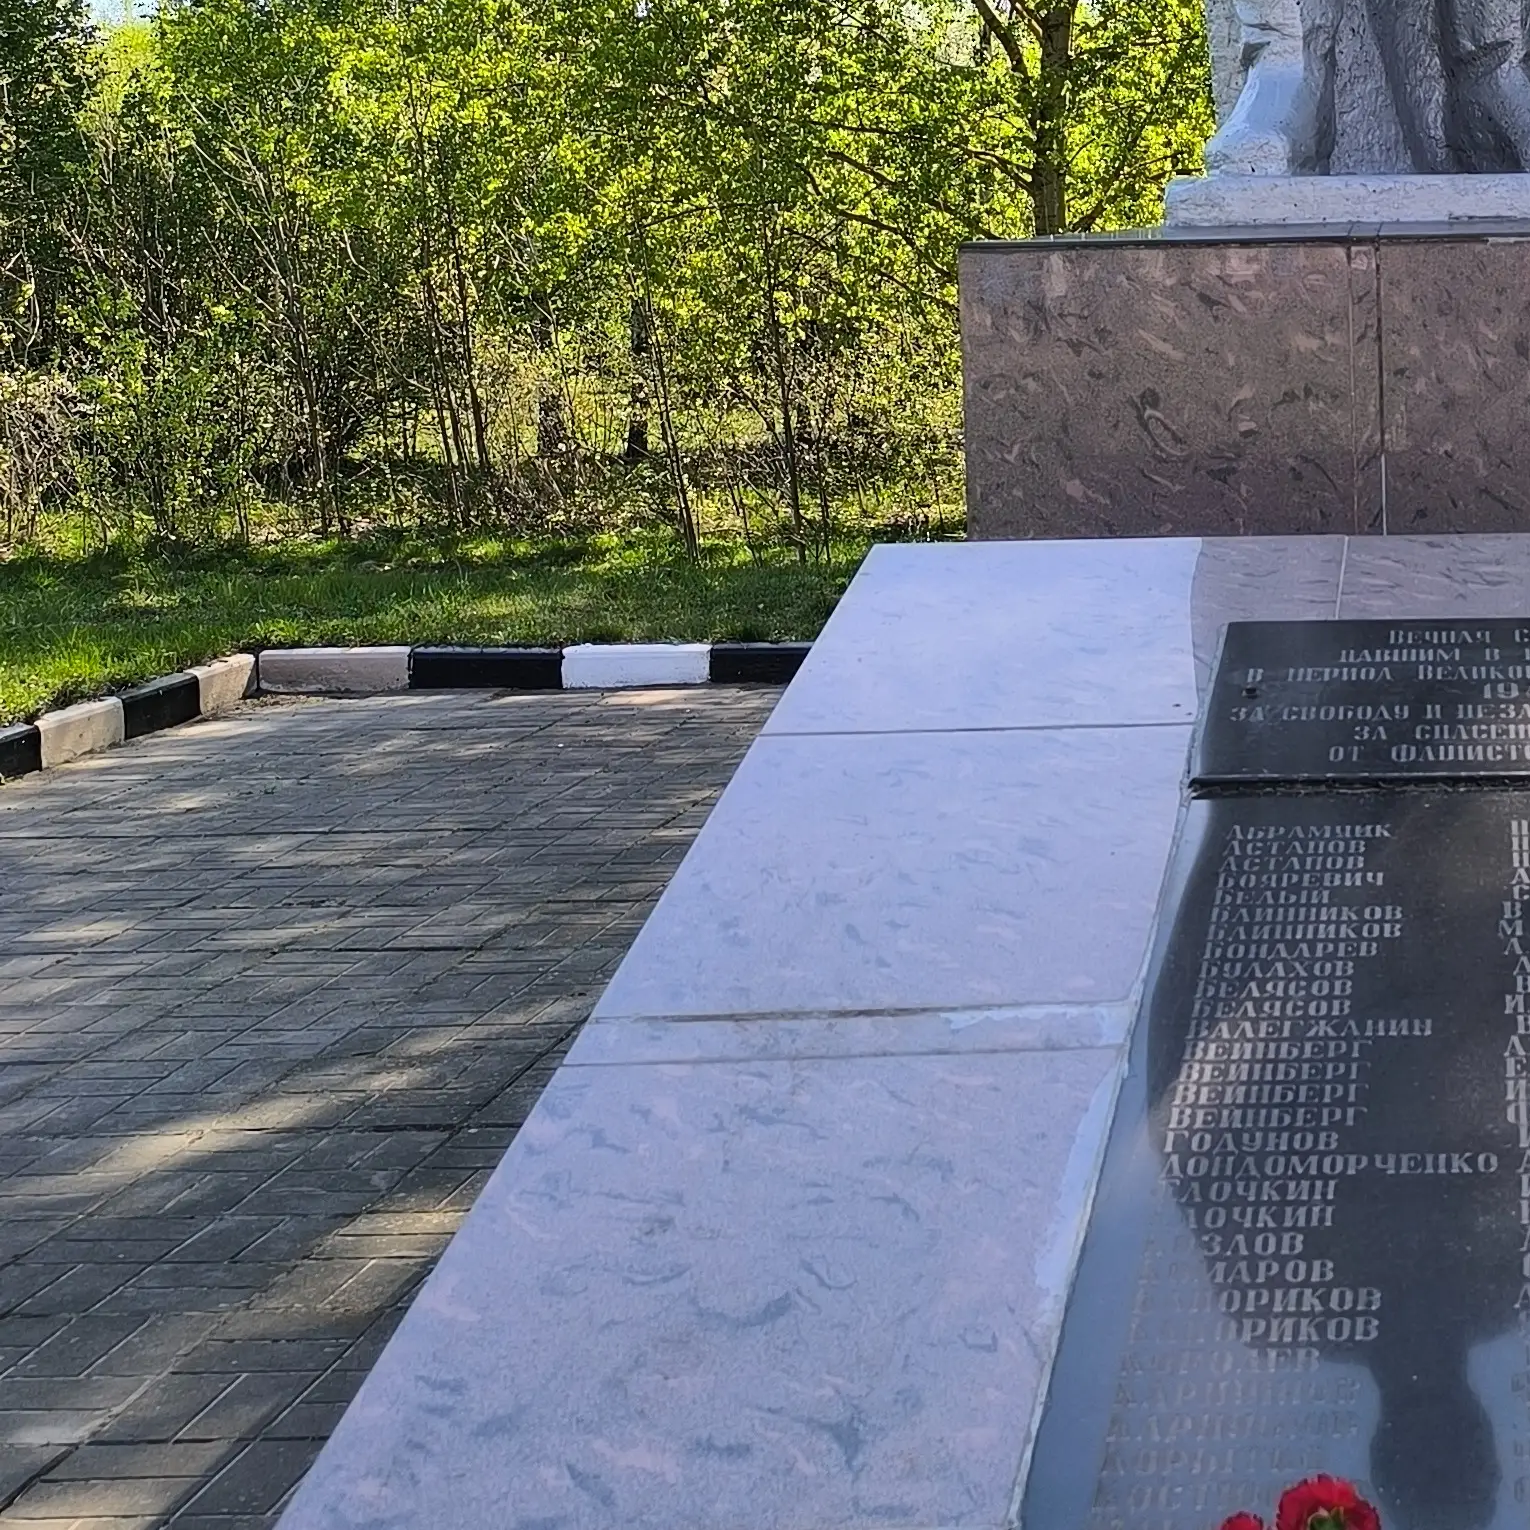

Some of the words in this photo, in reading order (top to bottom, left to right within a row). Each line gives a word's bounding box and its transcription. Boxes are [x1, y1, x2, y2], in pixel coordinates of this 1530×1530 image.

[1389, 629, 1491, 645] ВЕЧНАЯ
[1338, 648, 1461, 663] ПАВШИМ
[1484, 647, 1501, 662] В
[1246, 668, 1264, 683] В
[1228, 705, 1266, 721] ЗА
[1281, 705, 1410, 721] СВОБОДУ
[1424, 703, 1443, 720] И
[1352, 724, 1389, 741] ЗА
[1327, 745, 1366, 763] ОТ
[1225, 823, 1393, 840] АБРАМЧИК
[1221, 840, 1366, 857] АСТАПОВ
[1218, 856, 1366, 873] АСТАПОВ
[1217, 871, 1385, 889] БОЯРЕВИЧ
[1213, 887, 1332, 905] БЕЛЫЙ
[1209, 905, 1405, 923] БЛИННИКОВ
[1206, 922, 1403, 941] БЛИННИКОВ
[1202, 940, 1379, 960] БОНДАРЕВ
[1198, 960, 1354, 979] БУЛАХОВ
[1194, 978, 1353, 999] БЕЛЯСОВ
[1190, 998, 1352, 1019] БЕЛЯСОВ
[1181, 1039, 1373, 1061] ВЕЙНБЕРГ
[1177, 1061, 1372, 1083] ВЕЙНБЕРГ
[1171, 1083, 1370, 1106] ВЕЙНБЕРГ
[1167, 1105, 1369, 1130] ВЕЙНБЕРГ
[1164, 1131, 1340, 1155] ГОДУНОВ
[1150, 1205, 1338, 1230] ЛОЧКИН
